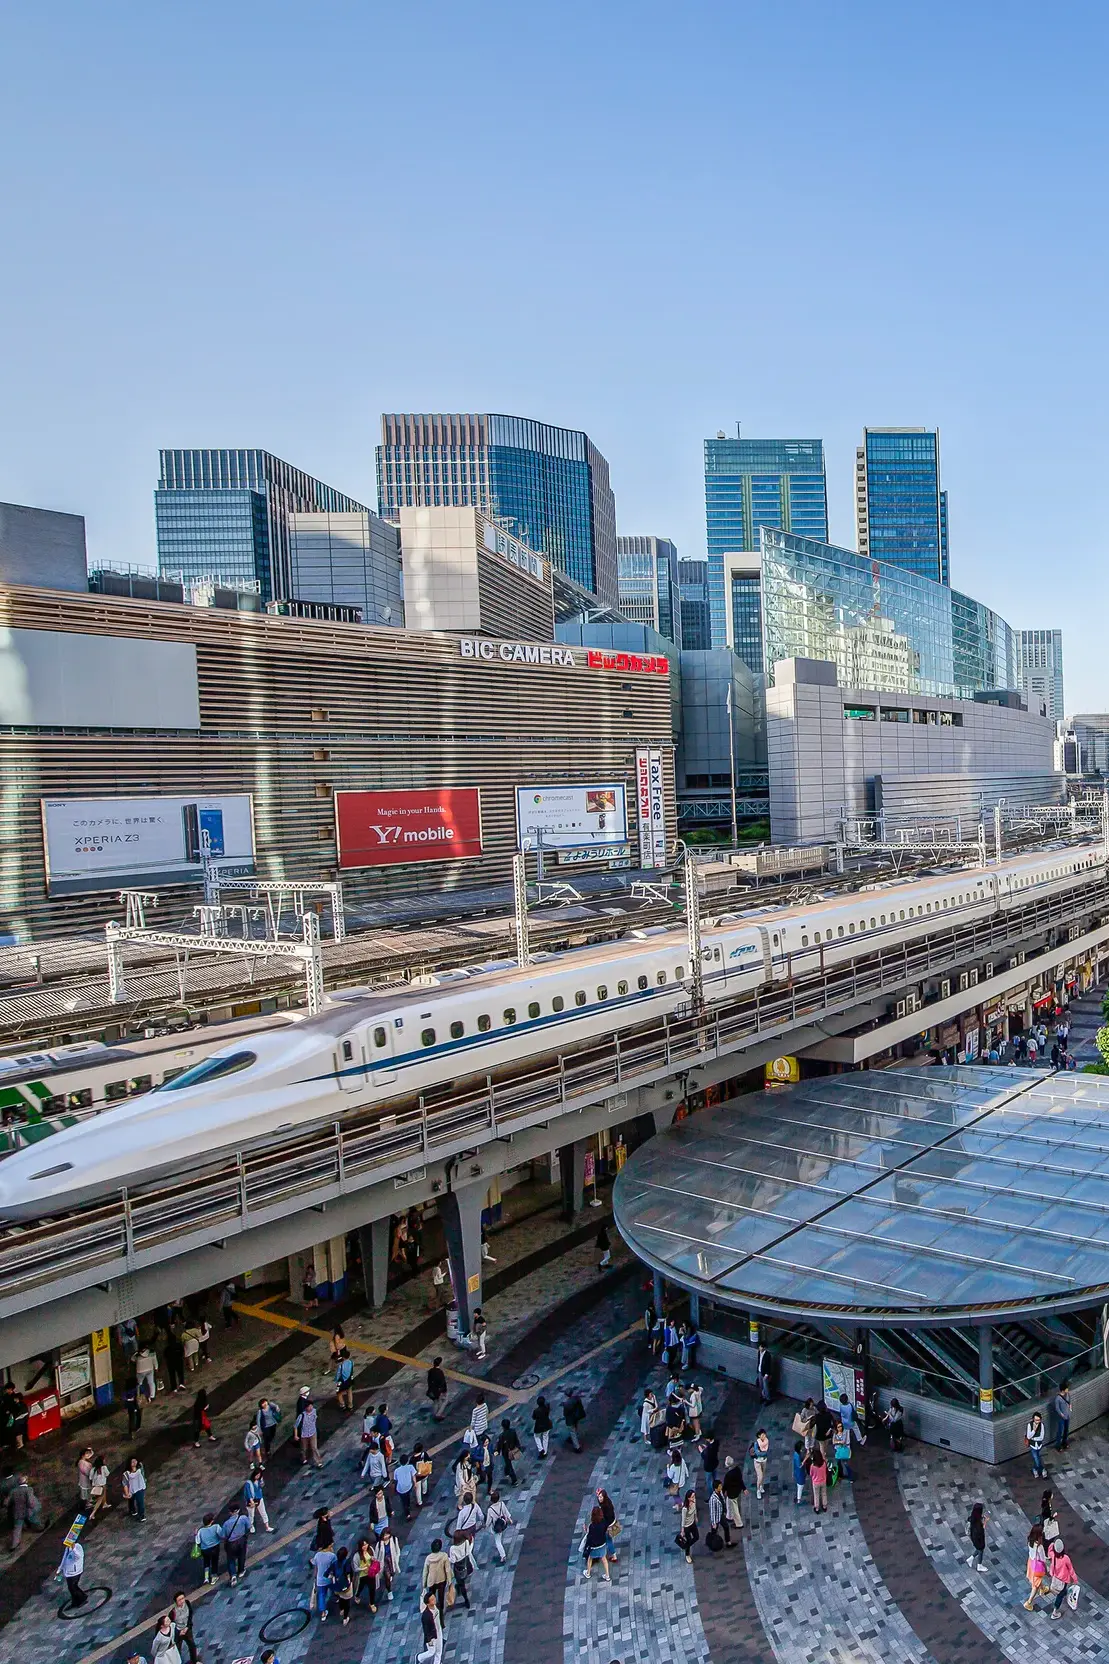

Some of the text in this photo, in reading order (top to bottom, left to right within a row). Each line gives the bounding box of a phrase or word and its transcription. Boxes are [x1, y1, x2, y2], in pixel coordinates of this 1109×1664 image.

[460, 639, 576, 666] BIC CAMERA
[587, 650, 669, 674] ビックカメラ
[639, 758, 650, 819] ビックカメラ
[651, 756, 662, 820] Tax Free
[377, 808, 398, 817] Magic
[406, 808, 423, 817] your
[424, 806, 447, 814] Hands.
[74, 834, 140, 845] XPERIA Z3
